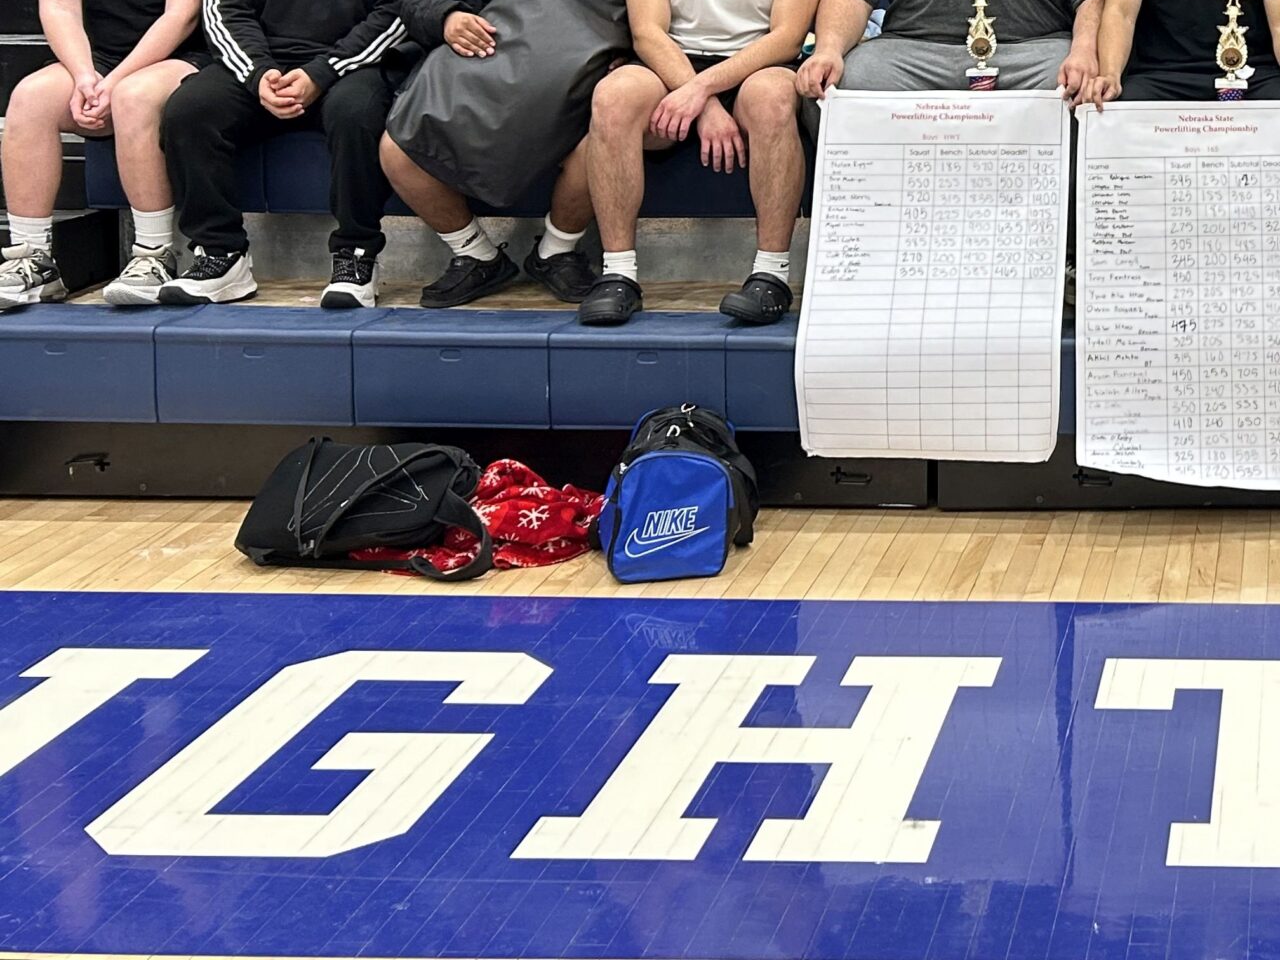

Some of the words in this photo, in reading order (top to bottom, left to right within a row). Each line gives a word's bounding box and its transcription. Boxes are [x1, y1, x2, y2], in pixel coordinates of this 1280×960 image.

[916, 103, 950, 111] Nebraska
[891, 112, 938, 122] Powerlifting
[939, 112, 994, 122] Championship
[1154, 125, 1201, 133] Powerlifting
[1203, 125, 1258, 133] Championship
[907, 161, 932, 173] 385
[1000, 161, 1025, 173] 425
[1170, 161, 1191, 169] Squat
[1230, 160, 1259, 168] Subtotal
[1171, 318, 1197, 332] 475
[642, 506, 698, 538] NIKE
